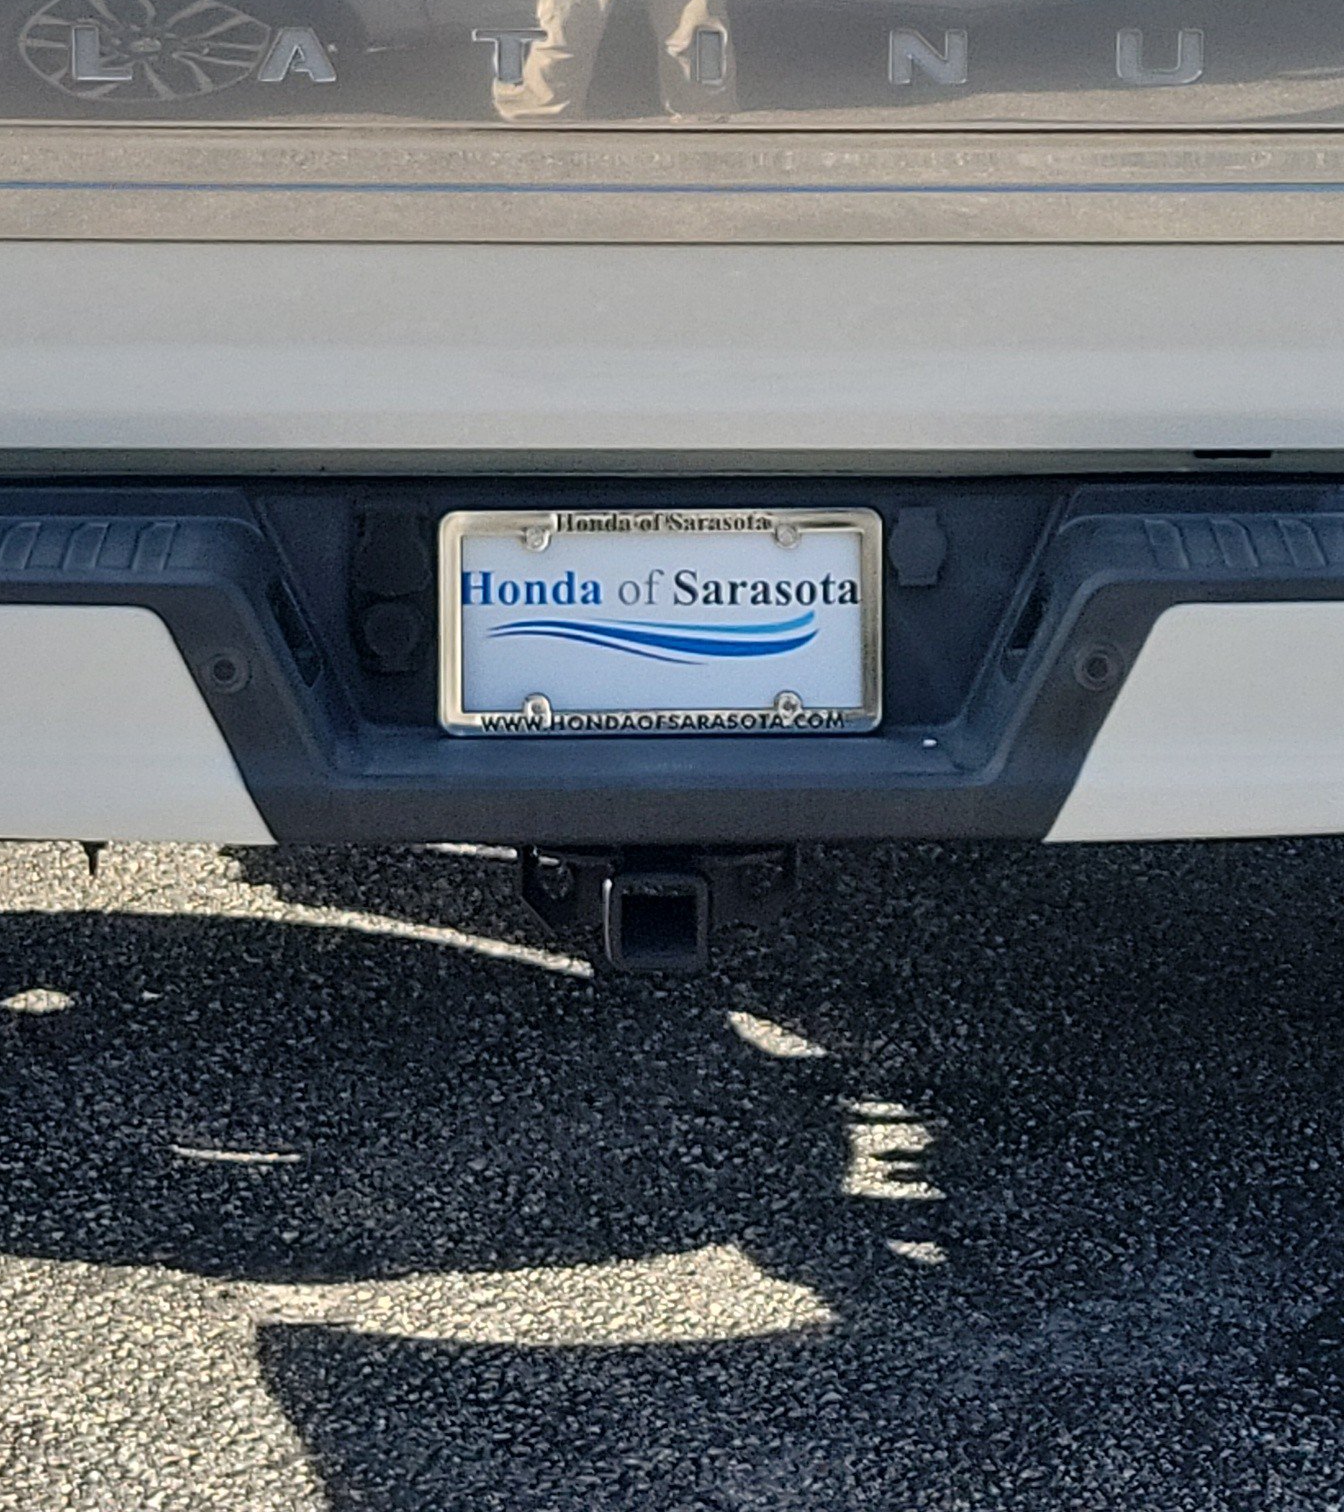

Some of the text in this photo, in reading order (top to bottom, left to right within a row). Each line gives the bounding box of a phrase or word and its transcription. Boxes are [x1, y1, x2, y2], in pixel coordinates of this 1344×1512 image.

[556, 512, 769, 532] Honda of Sarasota
[462, 569, 857, 606] Honda of Sarasota
[482, 713, 844, 732] WWW.HONDAOFSARASOTA.COM
